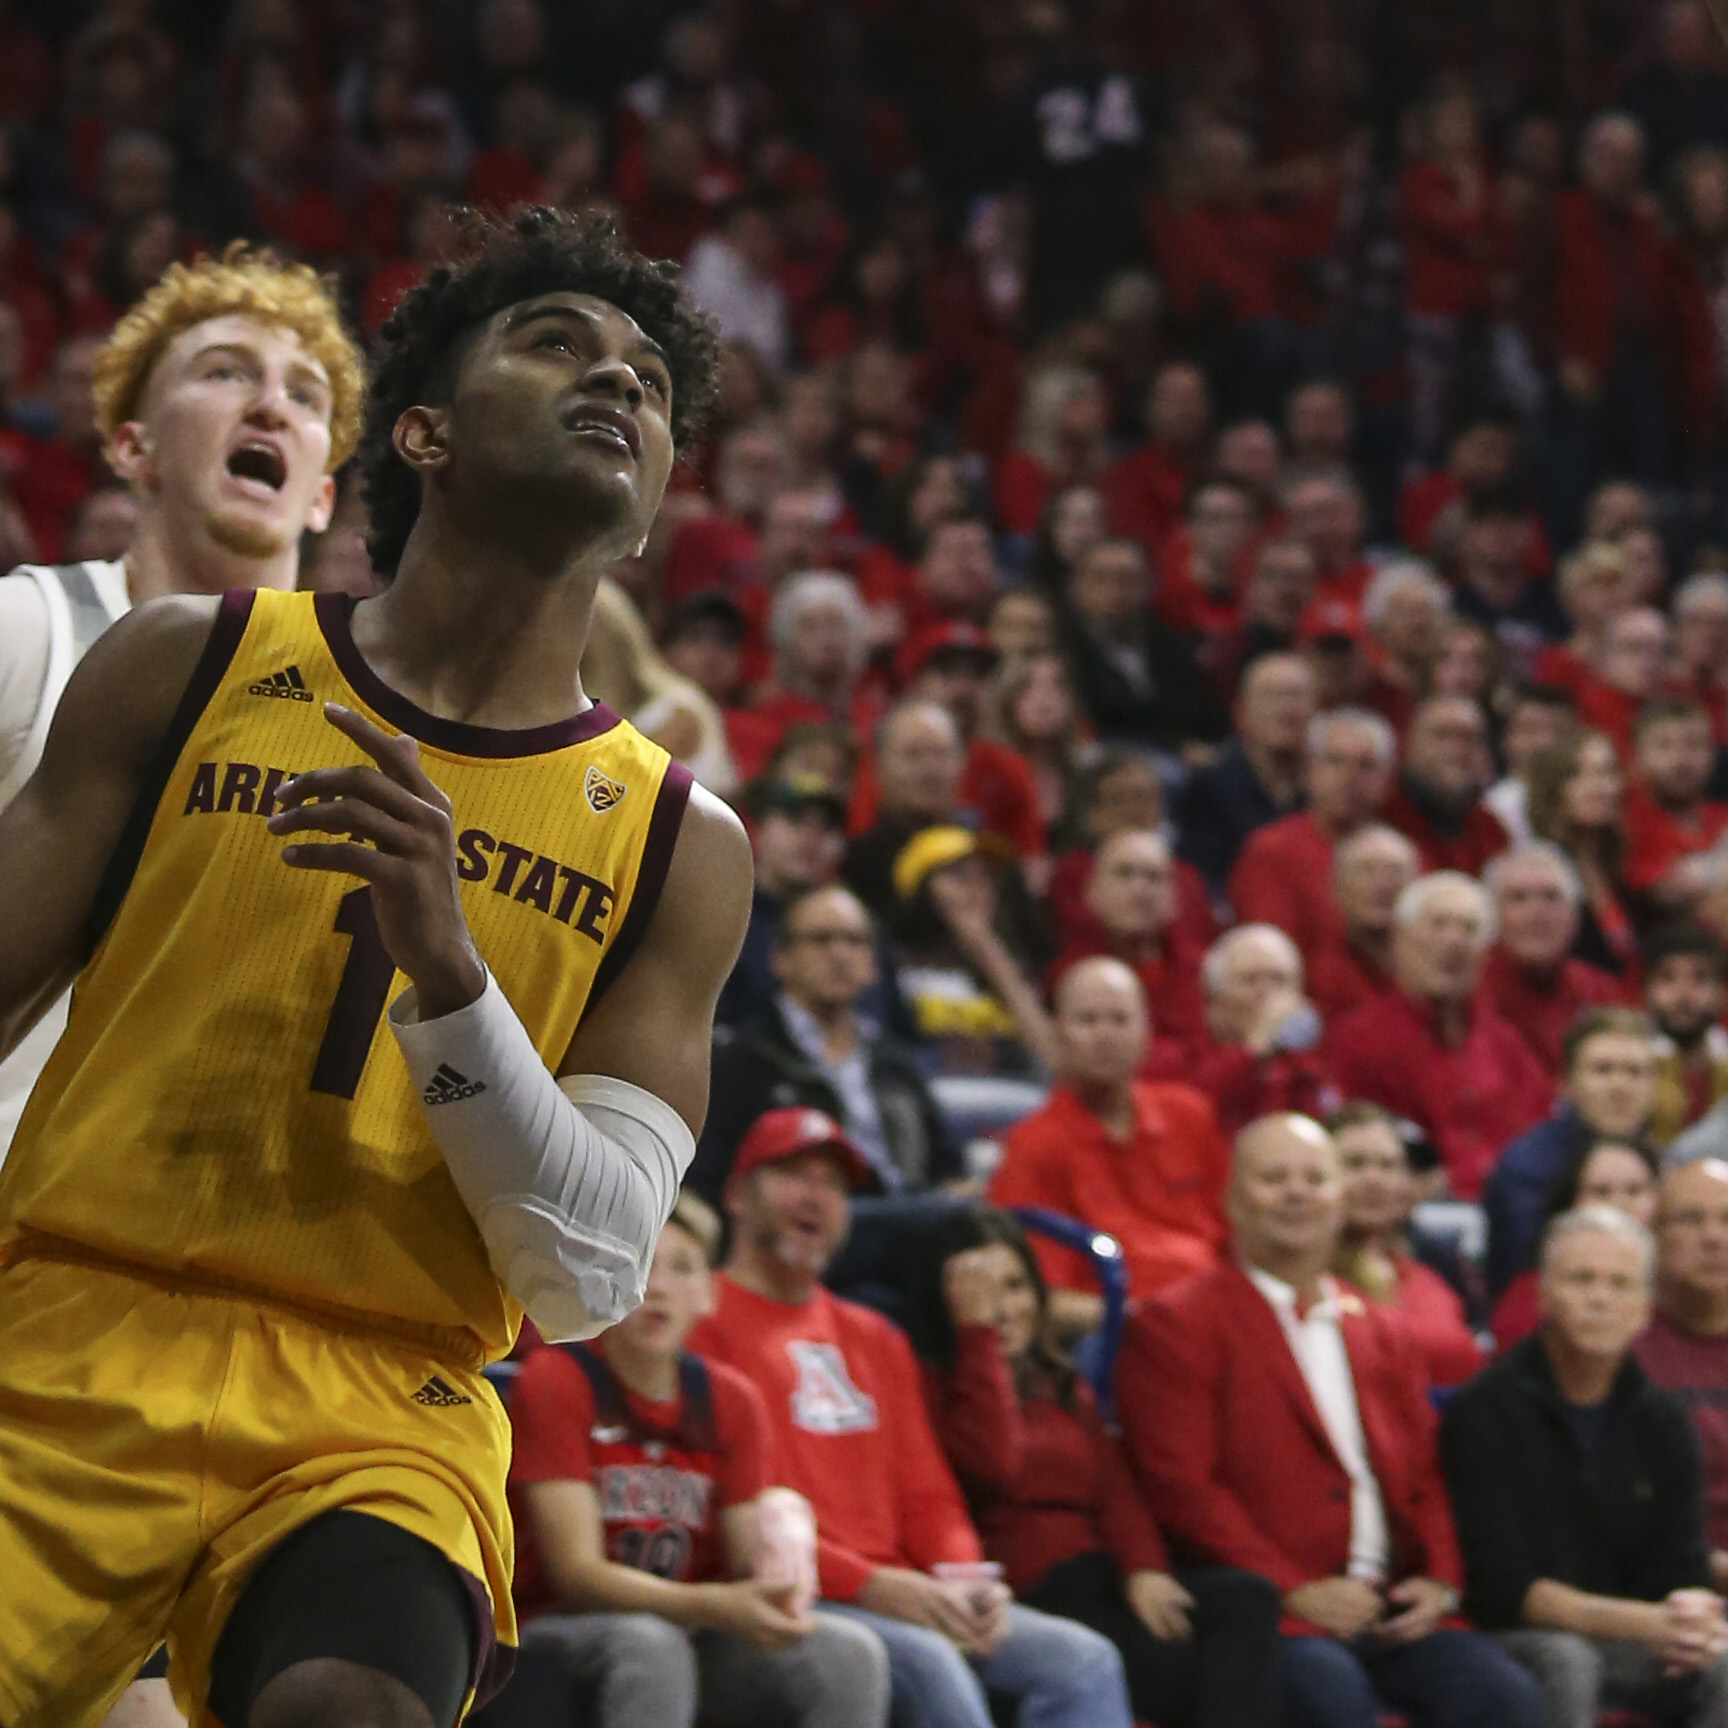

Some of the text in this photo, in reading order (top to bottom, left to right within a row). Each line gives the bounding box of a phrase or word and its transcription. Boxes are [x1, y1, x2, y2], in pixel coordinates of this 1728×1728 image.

[248, 684, 314, 702] adidas
[456, 828, 615, 945] STATE
[309, 884, 399, 1101] 1
[423, 1080, 487, 1106] adidas
